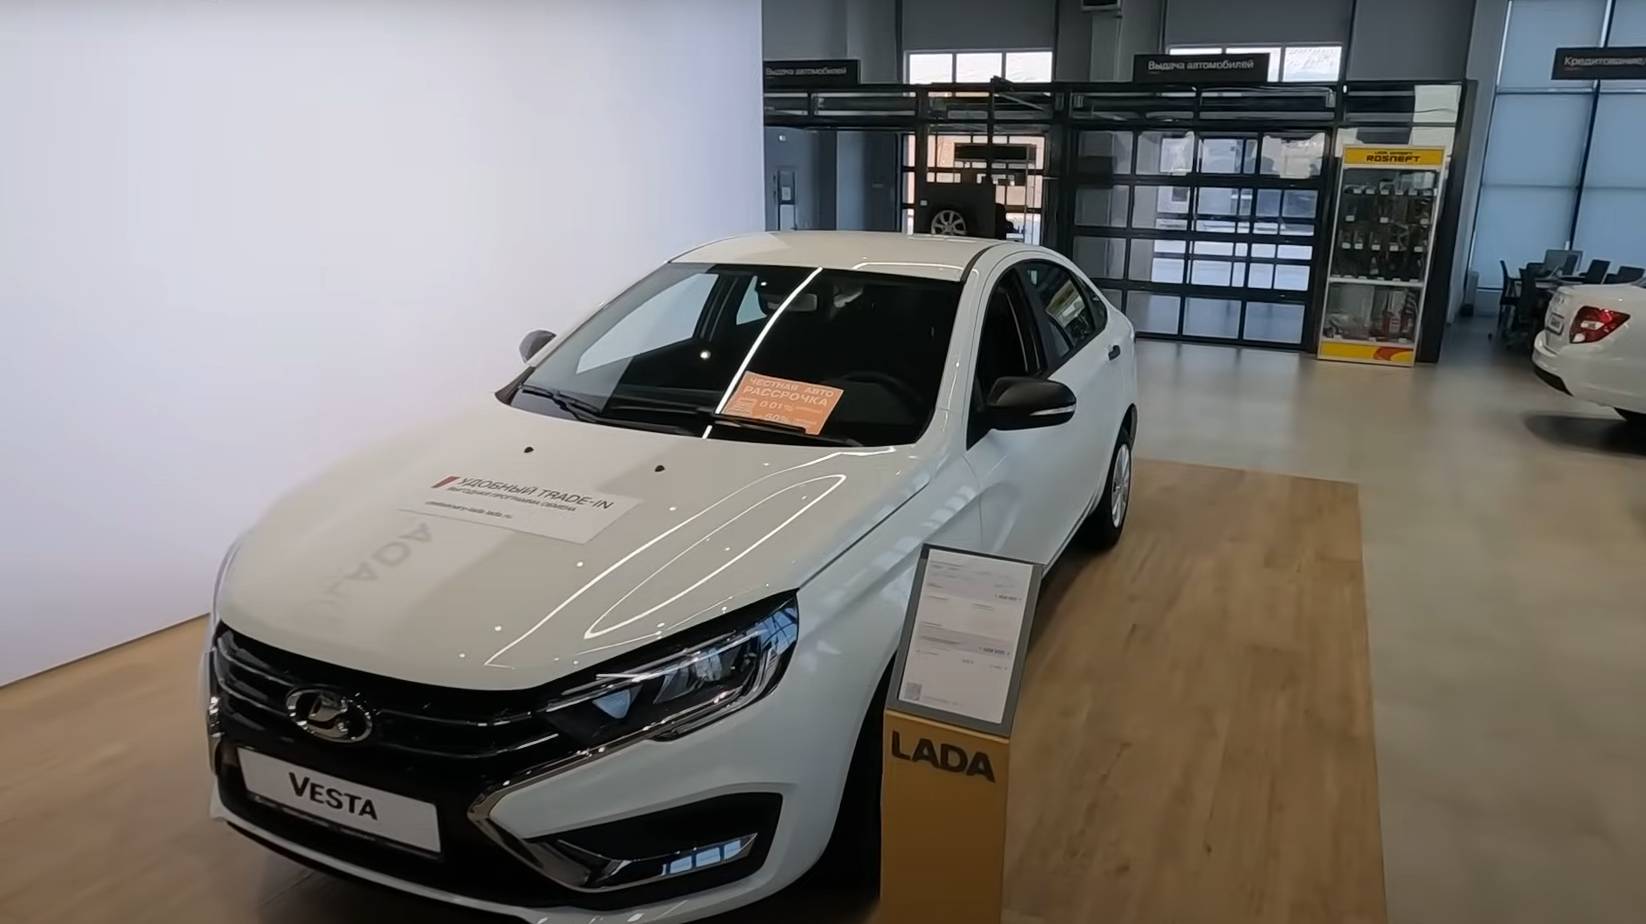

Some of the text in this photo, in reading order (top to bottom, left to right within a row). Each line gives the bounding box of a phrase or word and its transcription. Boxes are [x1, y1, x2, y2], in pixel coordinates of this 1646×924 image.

[1148, 59, 1254, 70] Выдача автомобилей
[743, 385, 828, 406] РАССРОЧКА
[750, 377, 834, 397] ЧЕСТНАЯ АВТО
[459, 478, 536, 495] УДОБНЫЙ
[537, 488, 614, 514] TRADE-IN
[891, 730, 996, 784] LADA
[288, 771, 378, 821] VESTA
